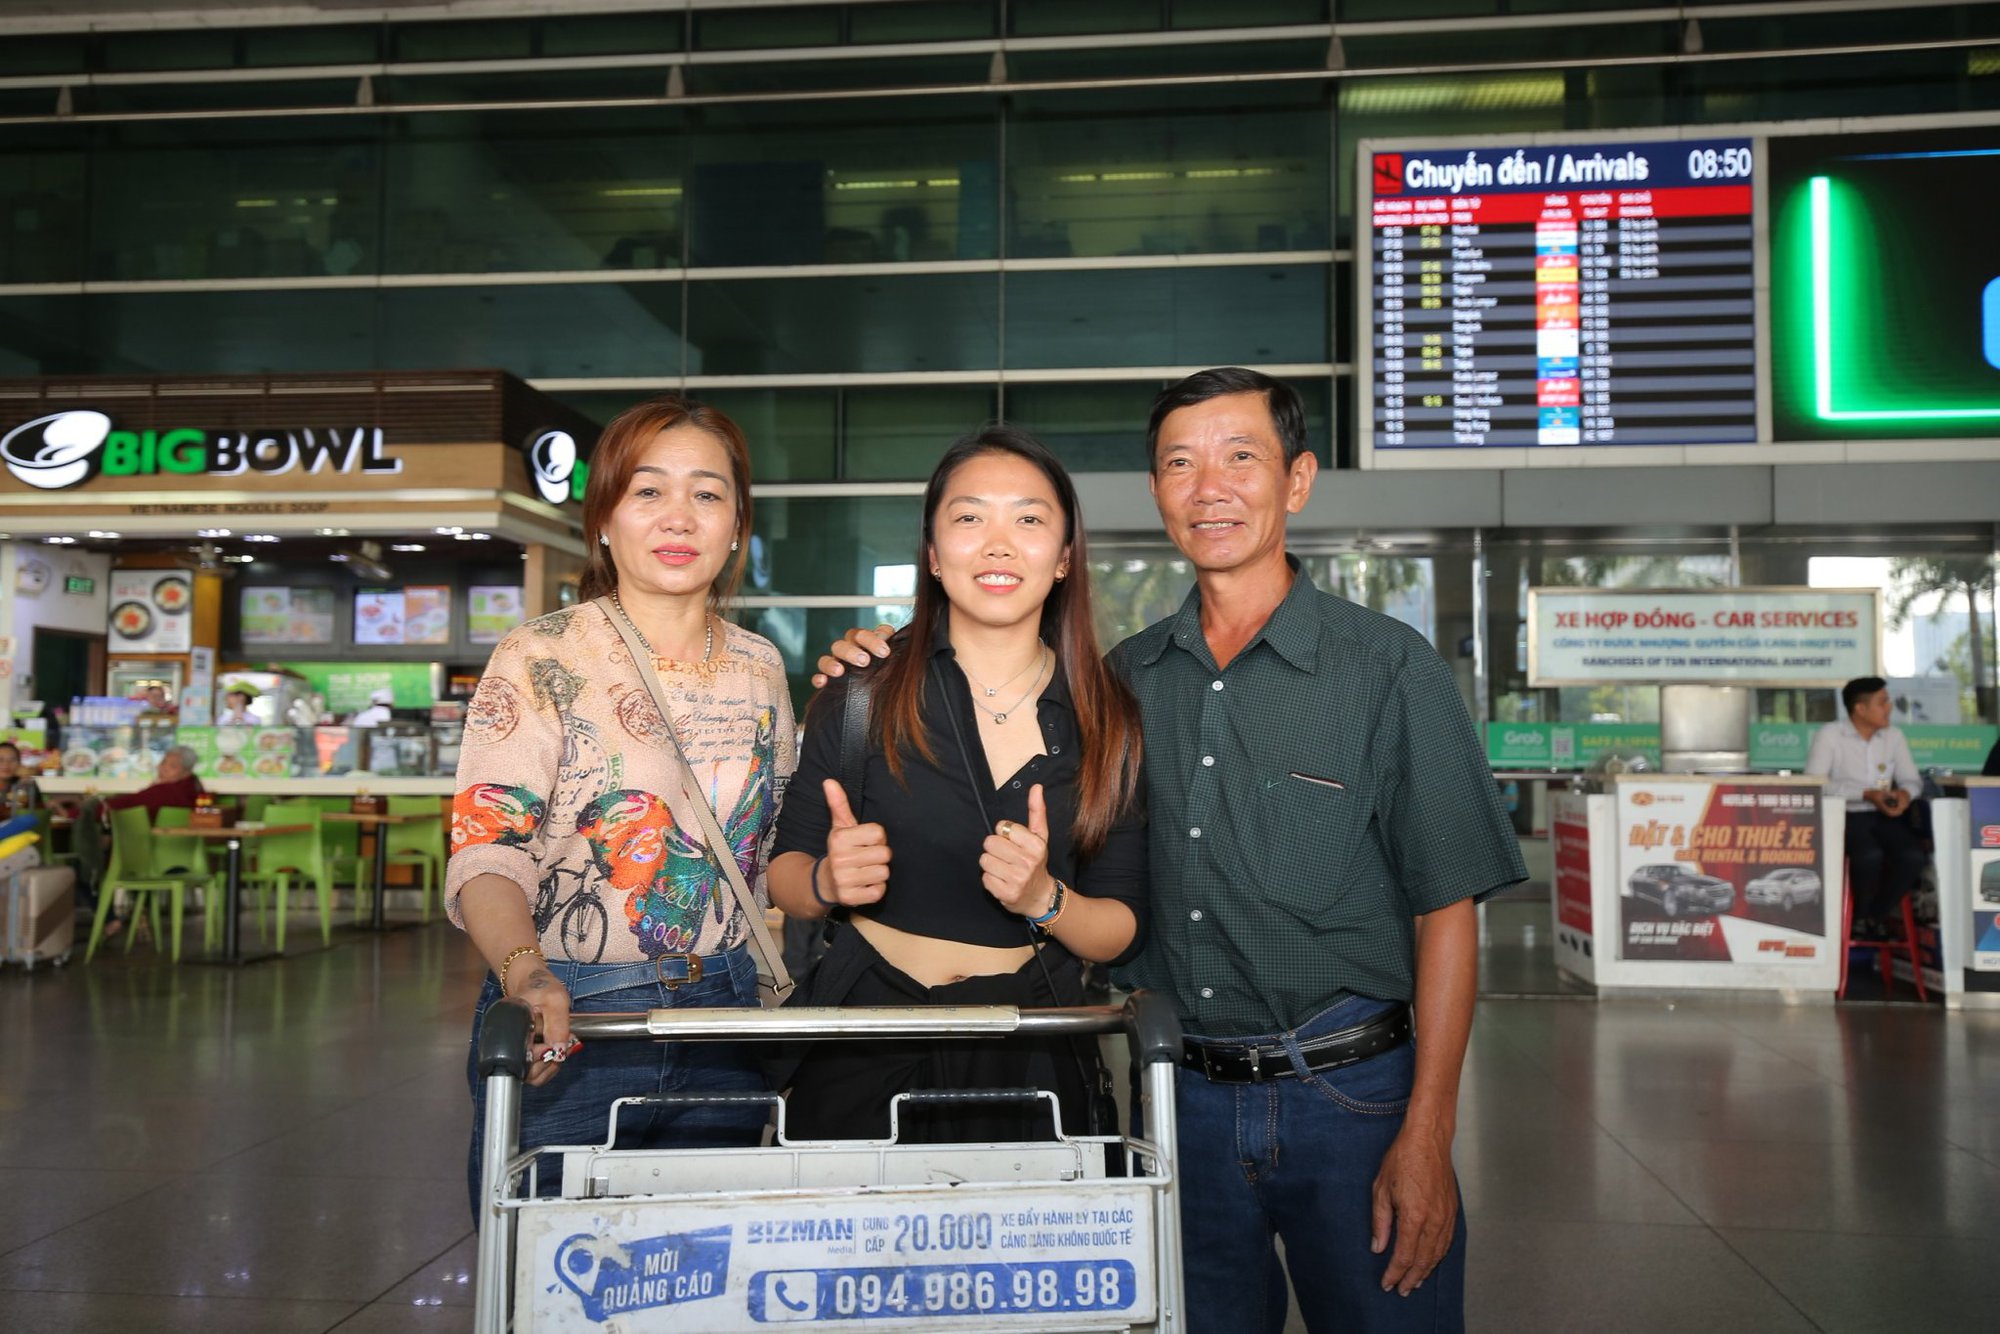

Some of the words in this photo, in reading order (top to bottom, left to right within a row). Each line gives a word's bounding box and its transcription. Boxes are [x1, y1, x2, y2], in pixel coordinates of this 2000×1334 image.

[1405, 151, 1493, 193] Chuyến
[1497, 149, 1541, 186] đến
[1545, 154, 1556, 183] /
[1558, 151, 1649, 184] Arrivals
[1688, 148, 1752, 179] 08:50
[130, 503, 218, 515] VIETNAMESE
[224, 502, 282, 515] NOODLE
[290, 502, 329, 514] SOUP
[1555, 612, 1579, 628] XE
[1585, 610, 1629, 631] HỢP
[1713, 611, 1755, 627] CAR
[1760, 611, 1858, 628] SERVICES
[1647, 656, 1661, 666] OF
[1690, 656, 1778, 666] INTERNATIONAL
[1783, 656, 1832, 666] AIRPORT
[1504, 730, 1543, 745] Grab
[1758, 731, 1799, 746] Grab
[1690, 825, 1732, 848] CHO
[1788, 826, 1815, 849] XE
[863, 1215, 889, 1232] CUNG
[1001, 1213, 1015, 1227] XE
[1043, 1210, 1073, 1226] HÀNH
[1092, 1210, 1109, 1226] TẠI
[1112, 1208, 1133, 1224] CÁC
[747, 1218, 853, 1244] BIZMAN
[894, 1212, 992, 1253] 20.000
[1000, 1230, 1027, 1249] CẢNG
[1058, 1230, 1090, 1247] KHÔNG
[1093, 1228, 1117, 1246] QUỐC
[1119, 1227, 1132, 1246] TẾ
[827, 1245, 853, 1255] Media
[865, 1235, 885, 1253] CẤP
[644, 1250, 678, 1277] MỜI
[603, 1276, 668, 1310] QUẢNG
[675, 1270, 713, 1298] CÁO
[835, 1267, 1120, 1315] 094.986.98.98
